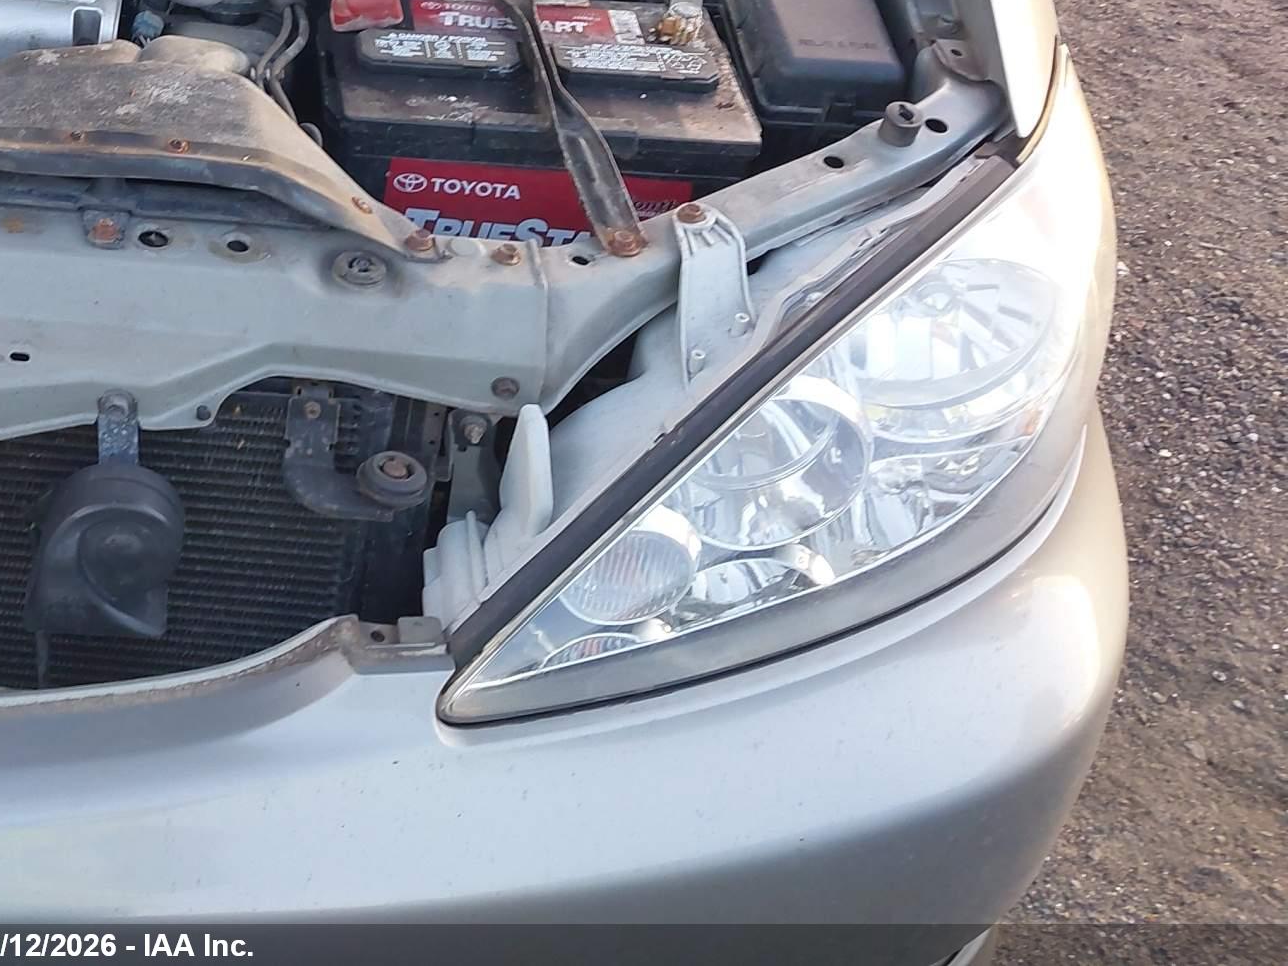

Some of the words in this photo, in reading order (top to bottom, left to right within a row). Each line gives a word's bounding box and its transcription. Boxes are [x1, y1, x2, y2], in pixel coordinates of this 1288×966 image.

[444, 1, 499, 13] TOYOTA
[430, 177, 521, 201] TOYOTA
[404, 207, 592, 248] TRUEST
